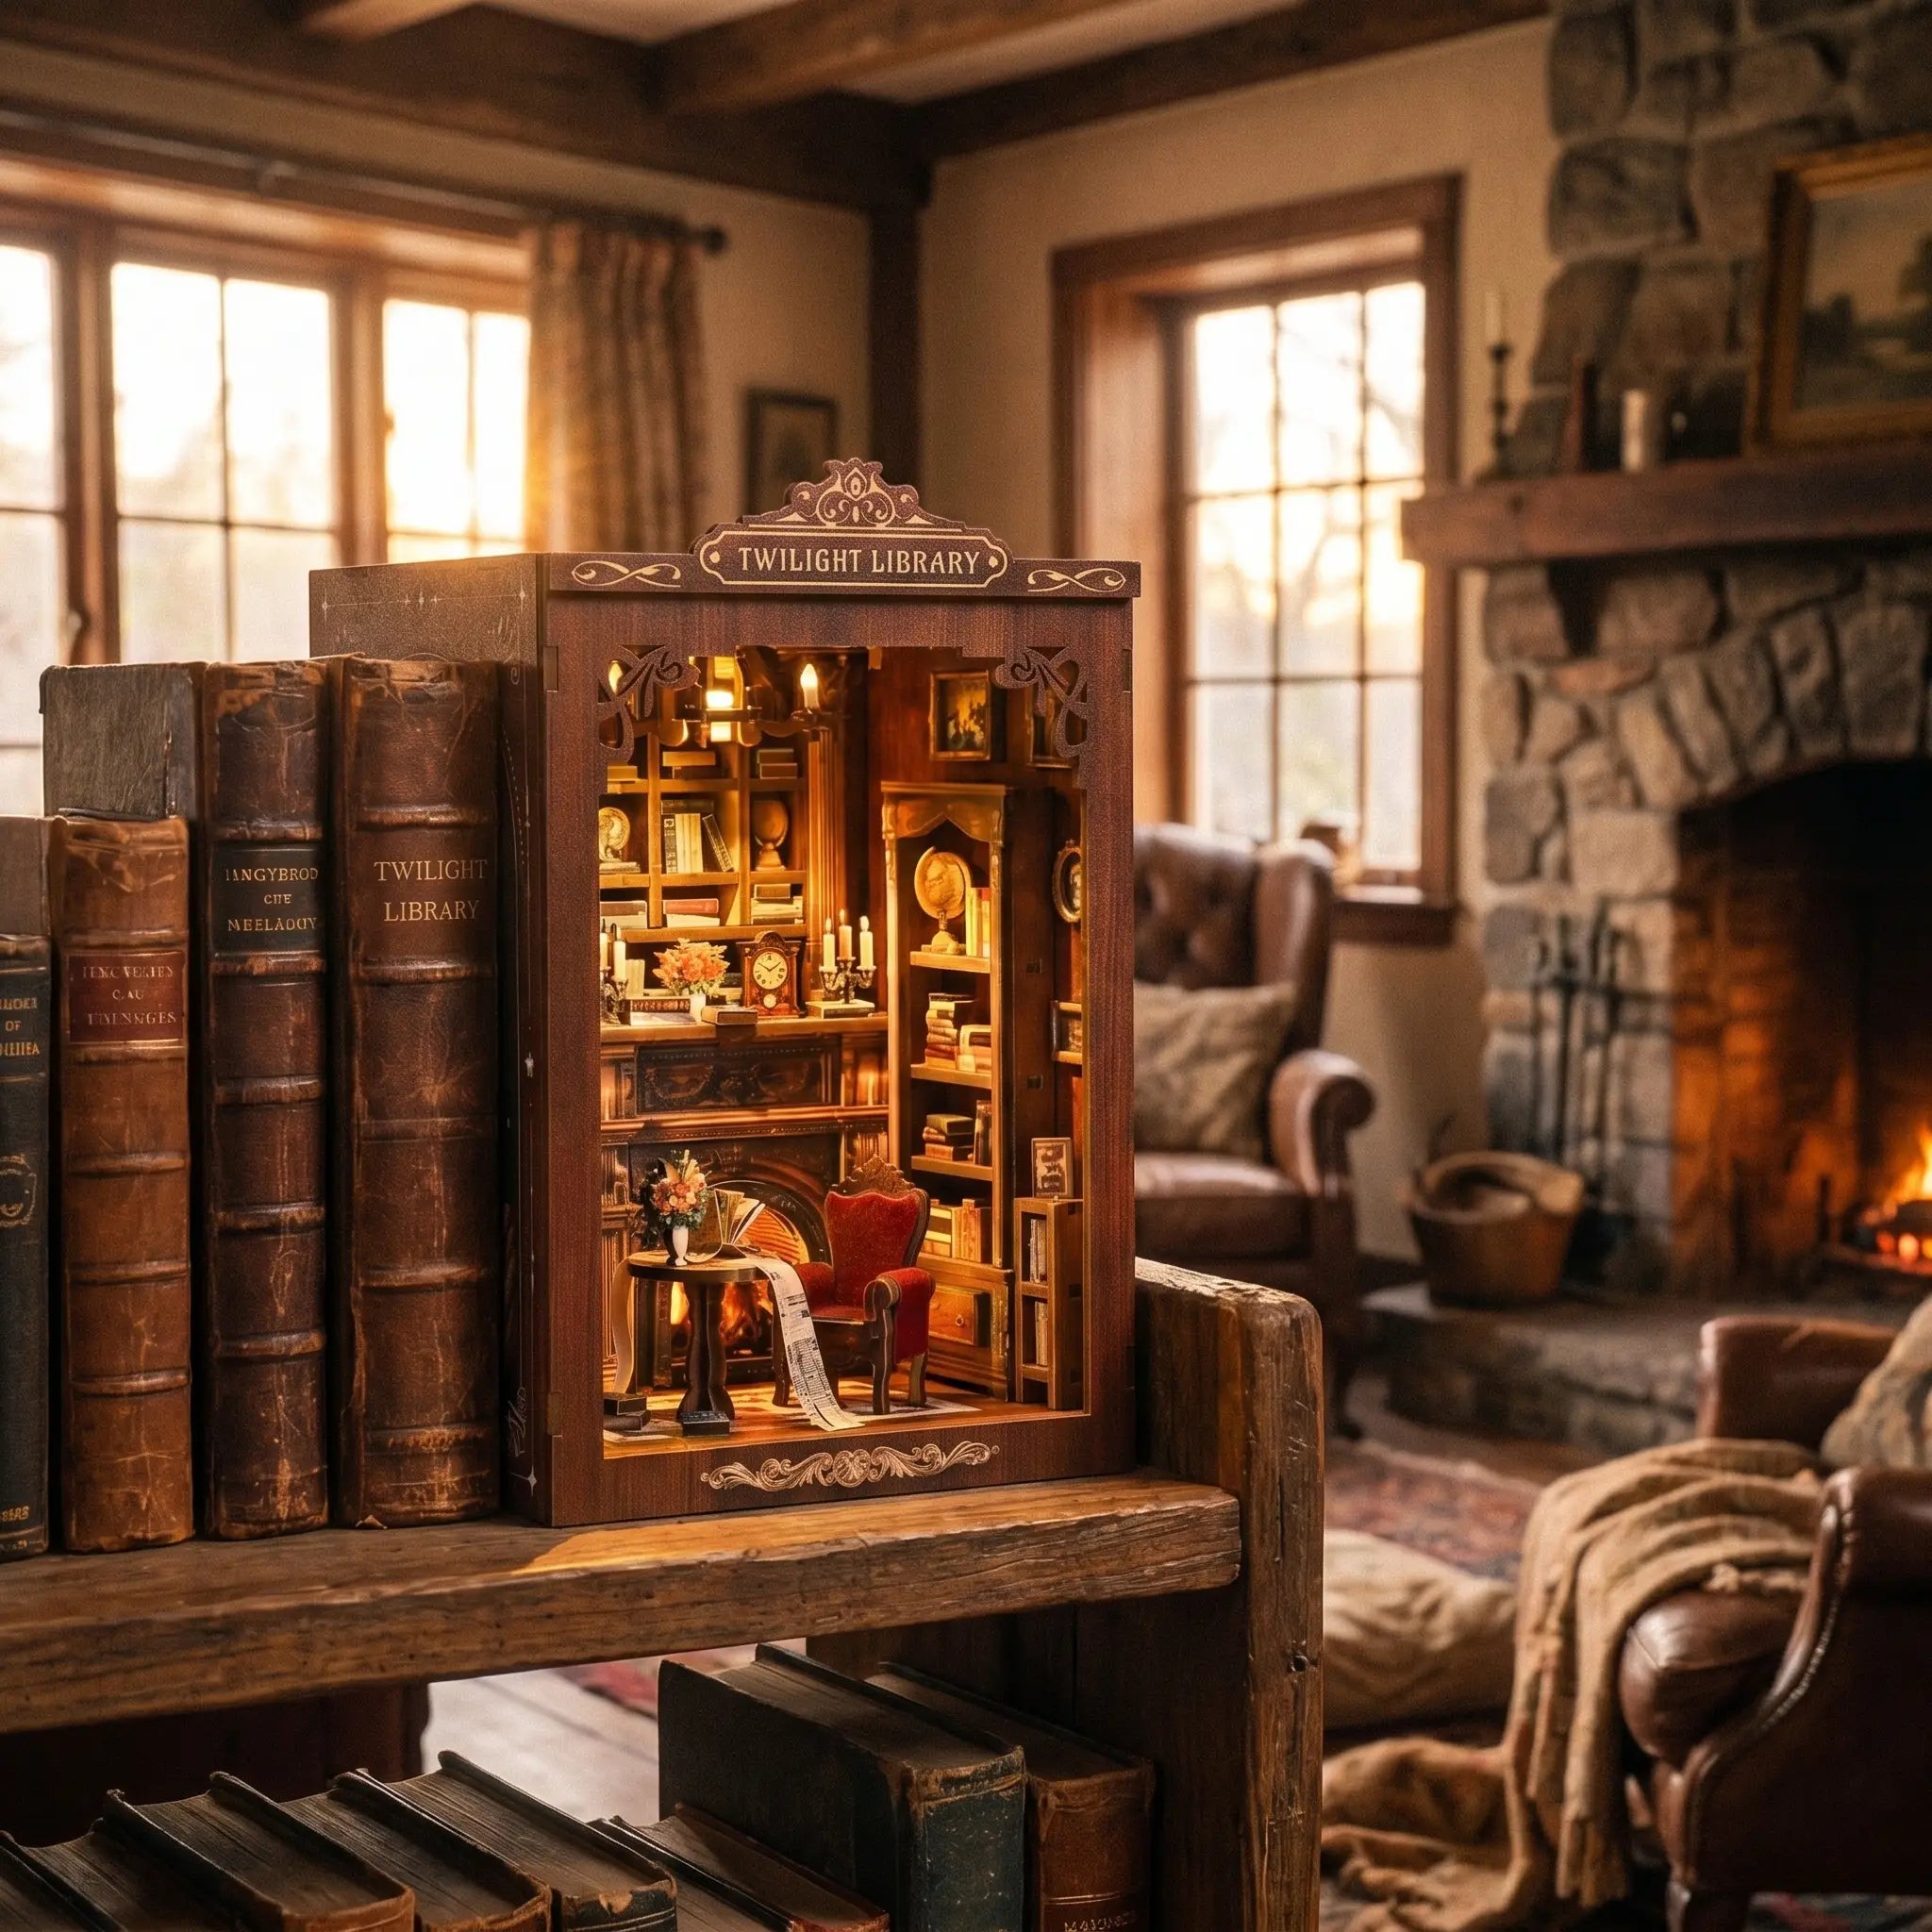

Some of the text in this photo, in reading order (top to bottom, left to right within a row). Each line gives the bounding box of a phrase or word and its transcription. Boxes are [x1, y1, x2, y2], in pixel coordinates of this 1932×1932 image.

[738, 547, 981, 575] TWILIGHT LIBRARY
[374, 859, 489, 881] TWILIGHT
[383, 899, 480, 922] LIBRARY
[5, 1020, 22, 1032] OF
